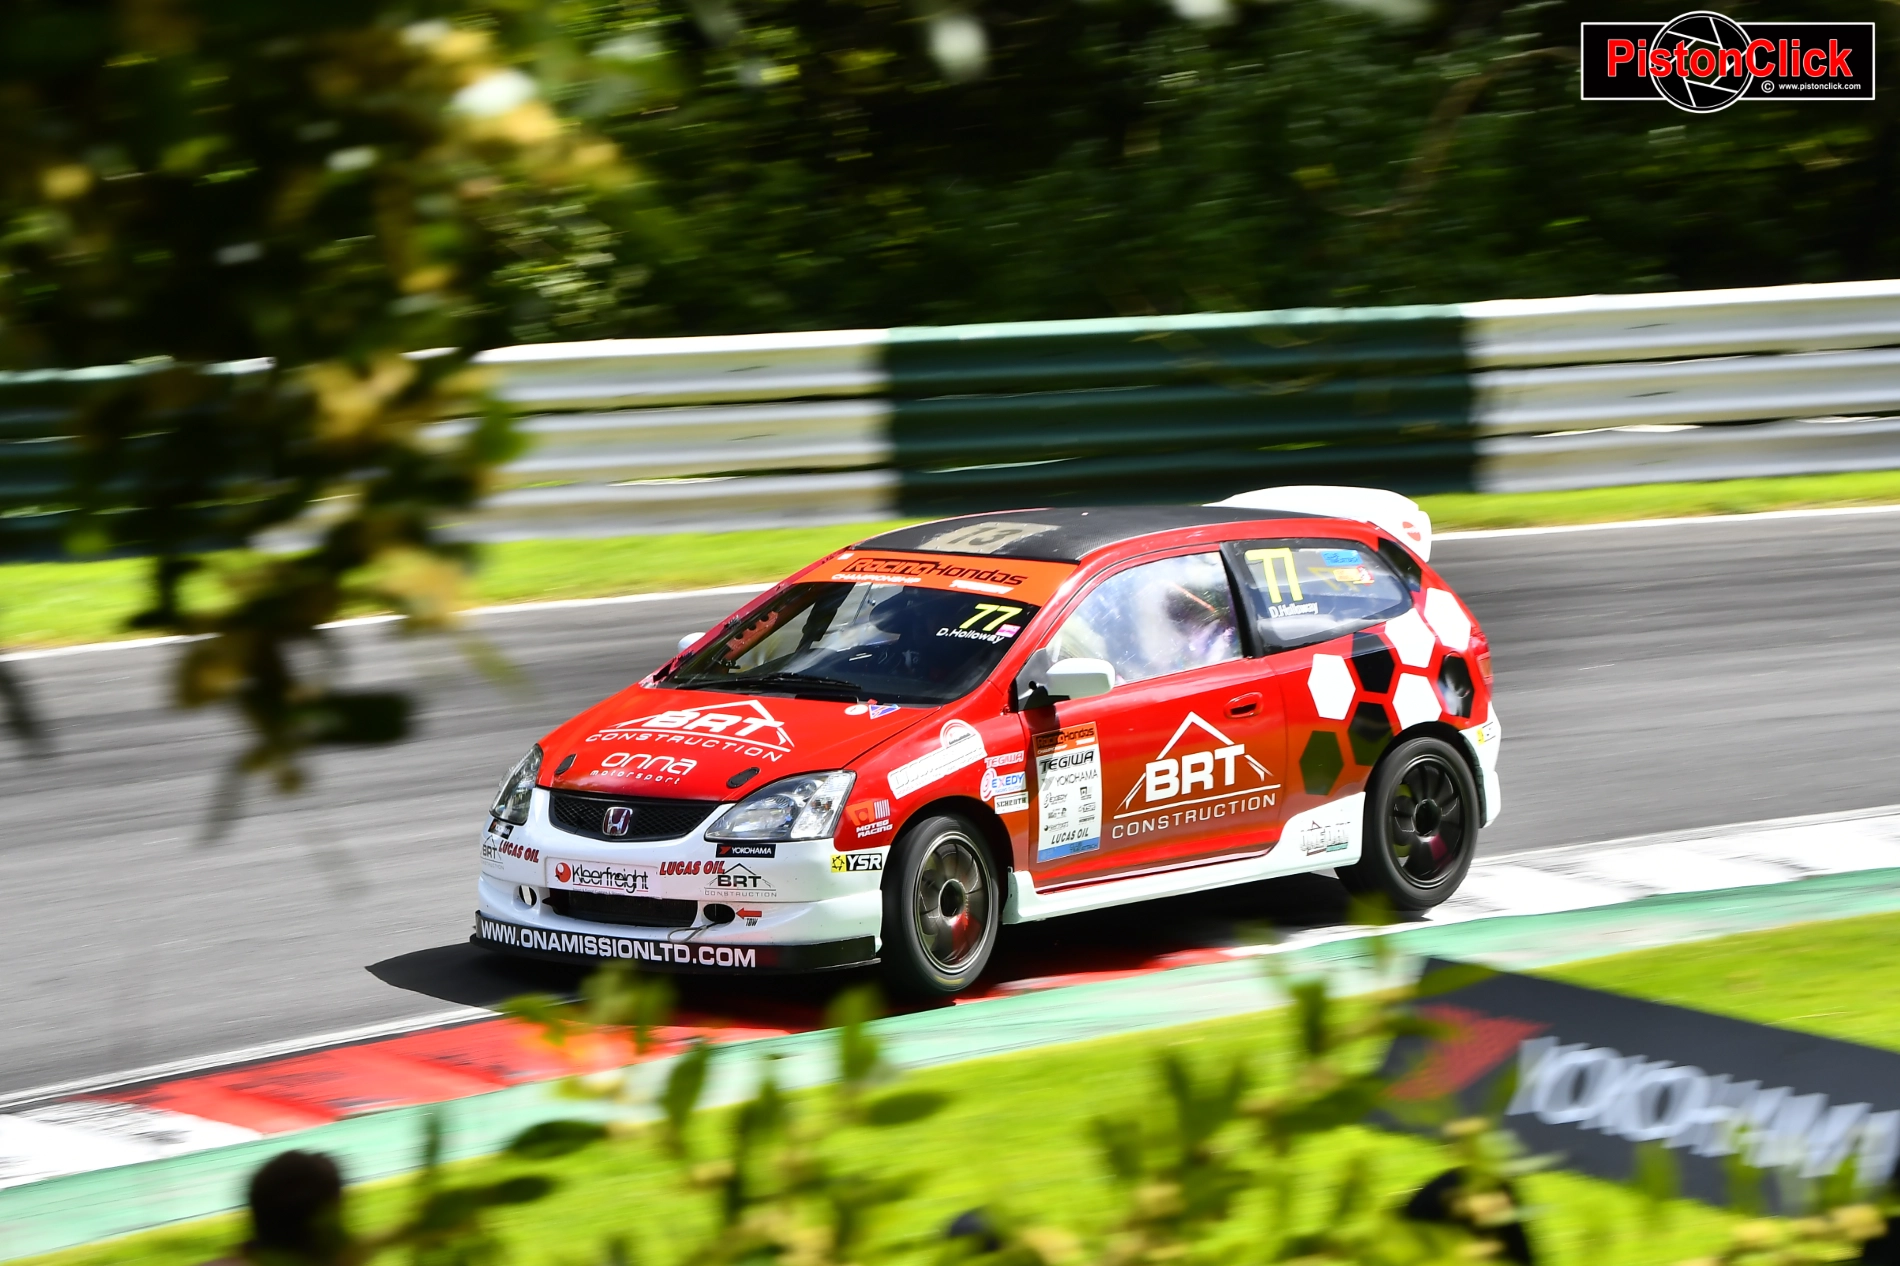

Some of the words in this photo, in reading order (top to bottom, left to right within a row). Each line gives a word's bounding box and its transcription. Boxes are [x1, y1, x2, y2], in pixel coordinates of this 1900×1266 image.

[1244, 547, 1303, 604] 77
[959, 603, 1023, 632] 77
[936, 627, 1005, 645] D.Holloway
[641, 709, 785, 737] BRT
[585, 732, 783, 763] CONSTRUCTION
[601, 752, 698, 776] onna
[1039, 749, 1095, 774] TEGIWA
[1145, 743, 1245, 802] BRT
[590, 769, 681, 785] motorsport
[991, 772, 1025, 788] EXEDY
[1056, 769, 1098, 786] YOKOHAMA
[1111, 792, 1276, 839] CONSTRUCTION
[1051, 830, 1076, 845] LUCAS
[1077, 827, 1089, 839] OIL
[498, 840, 524, 859] LUCAS
[524, 847, 540, 863] OIL
[847, 854, 882, 870] YSR
[572, 864, 649, 893] Kleerfreight
[660, 861, 701, 876] LUCAS
[703, 860, 726, 875] OIL
[717, 875, 762, 888] BRT
[481, 920, 756, 968] WWW.ONAMISSIONLTD.COM
